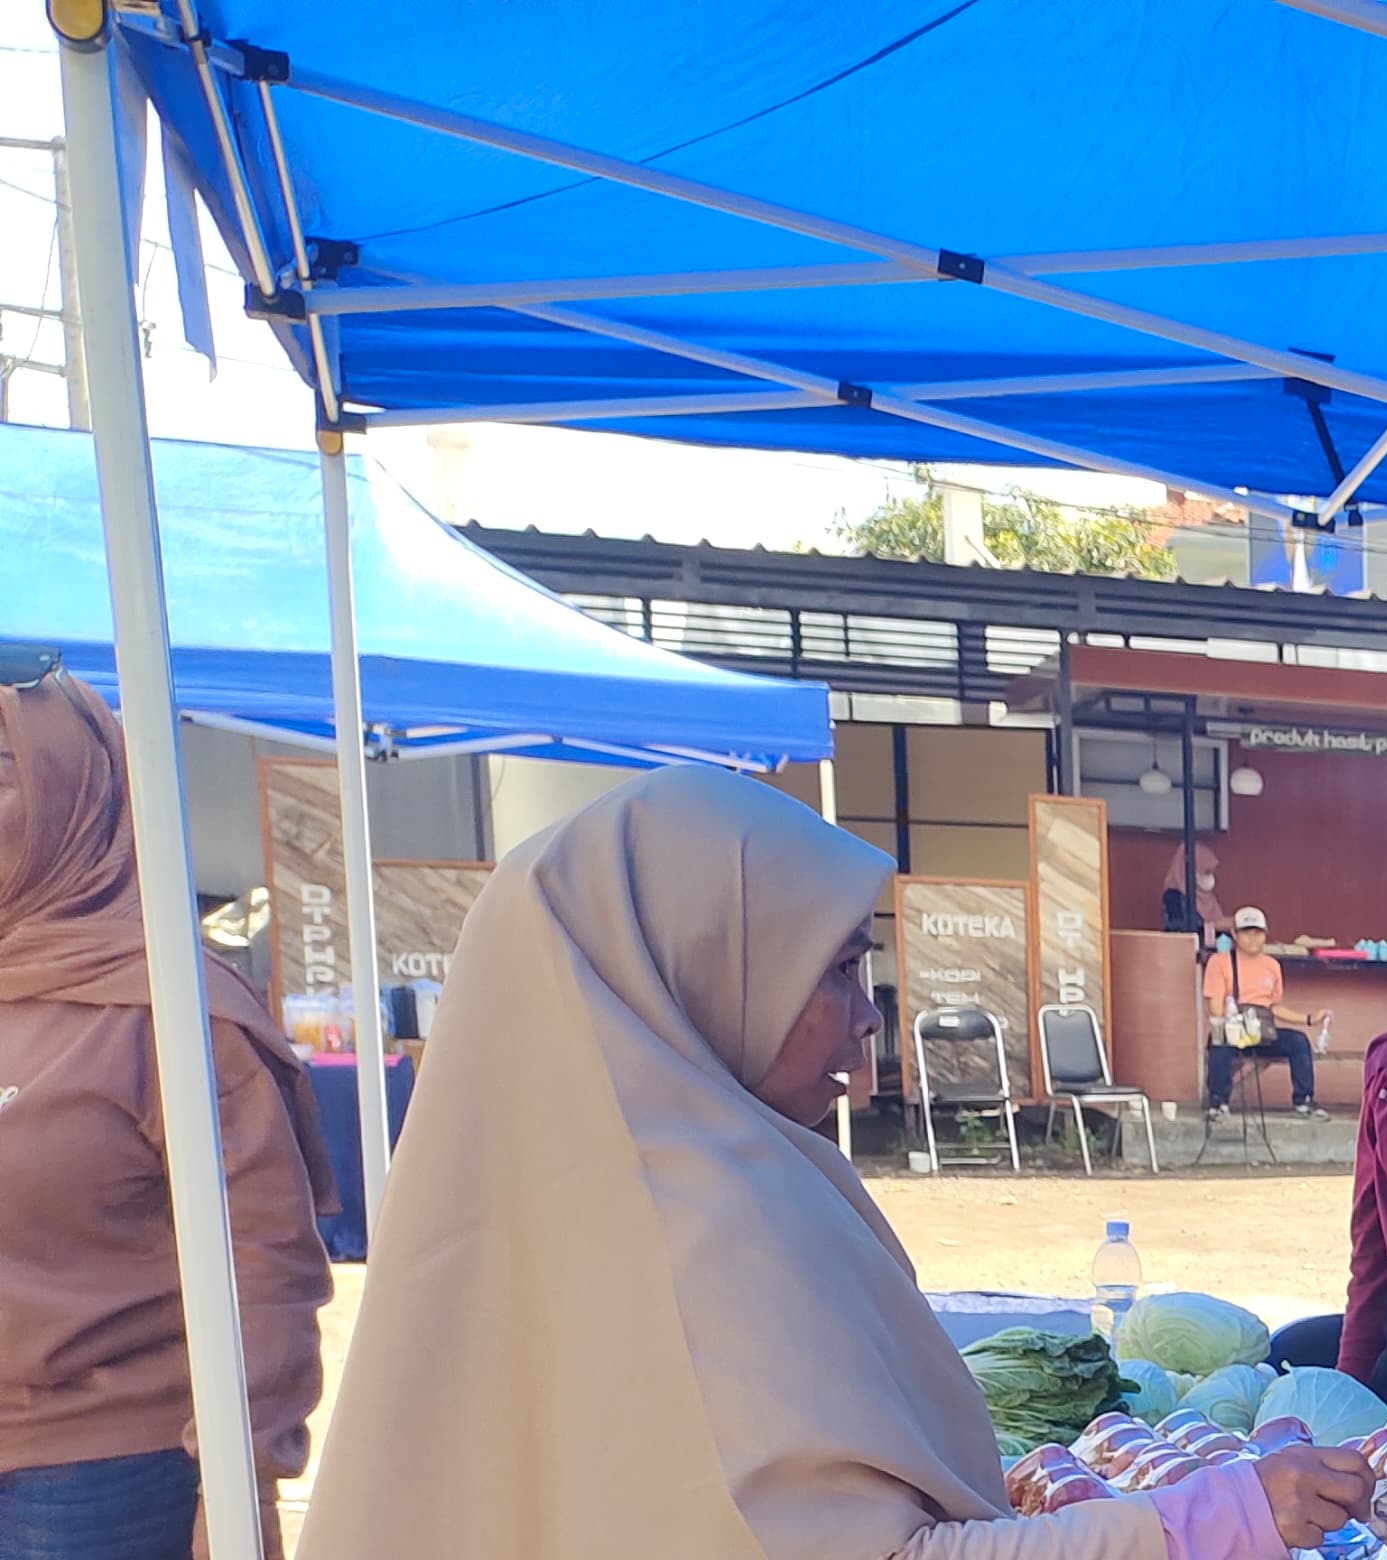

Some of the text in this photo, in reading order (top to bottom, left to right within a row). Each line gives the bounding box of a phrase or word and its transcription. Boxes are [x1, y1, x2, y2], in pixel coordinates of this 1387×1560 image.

[1249, 727, 1320, 747] produk
[1323, 730, 1372, 752] hasil
[922, 912, 1016, 937] KOTEKA
